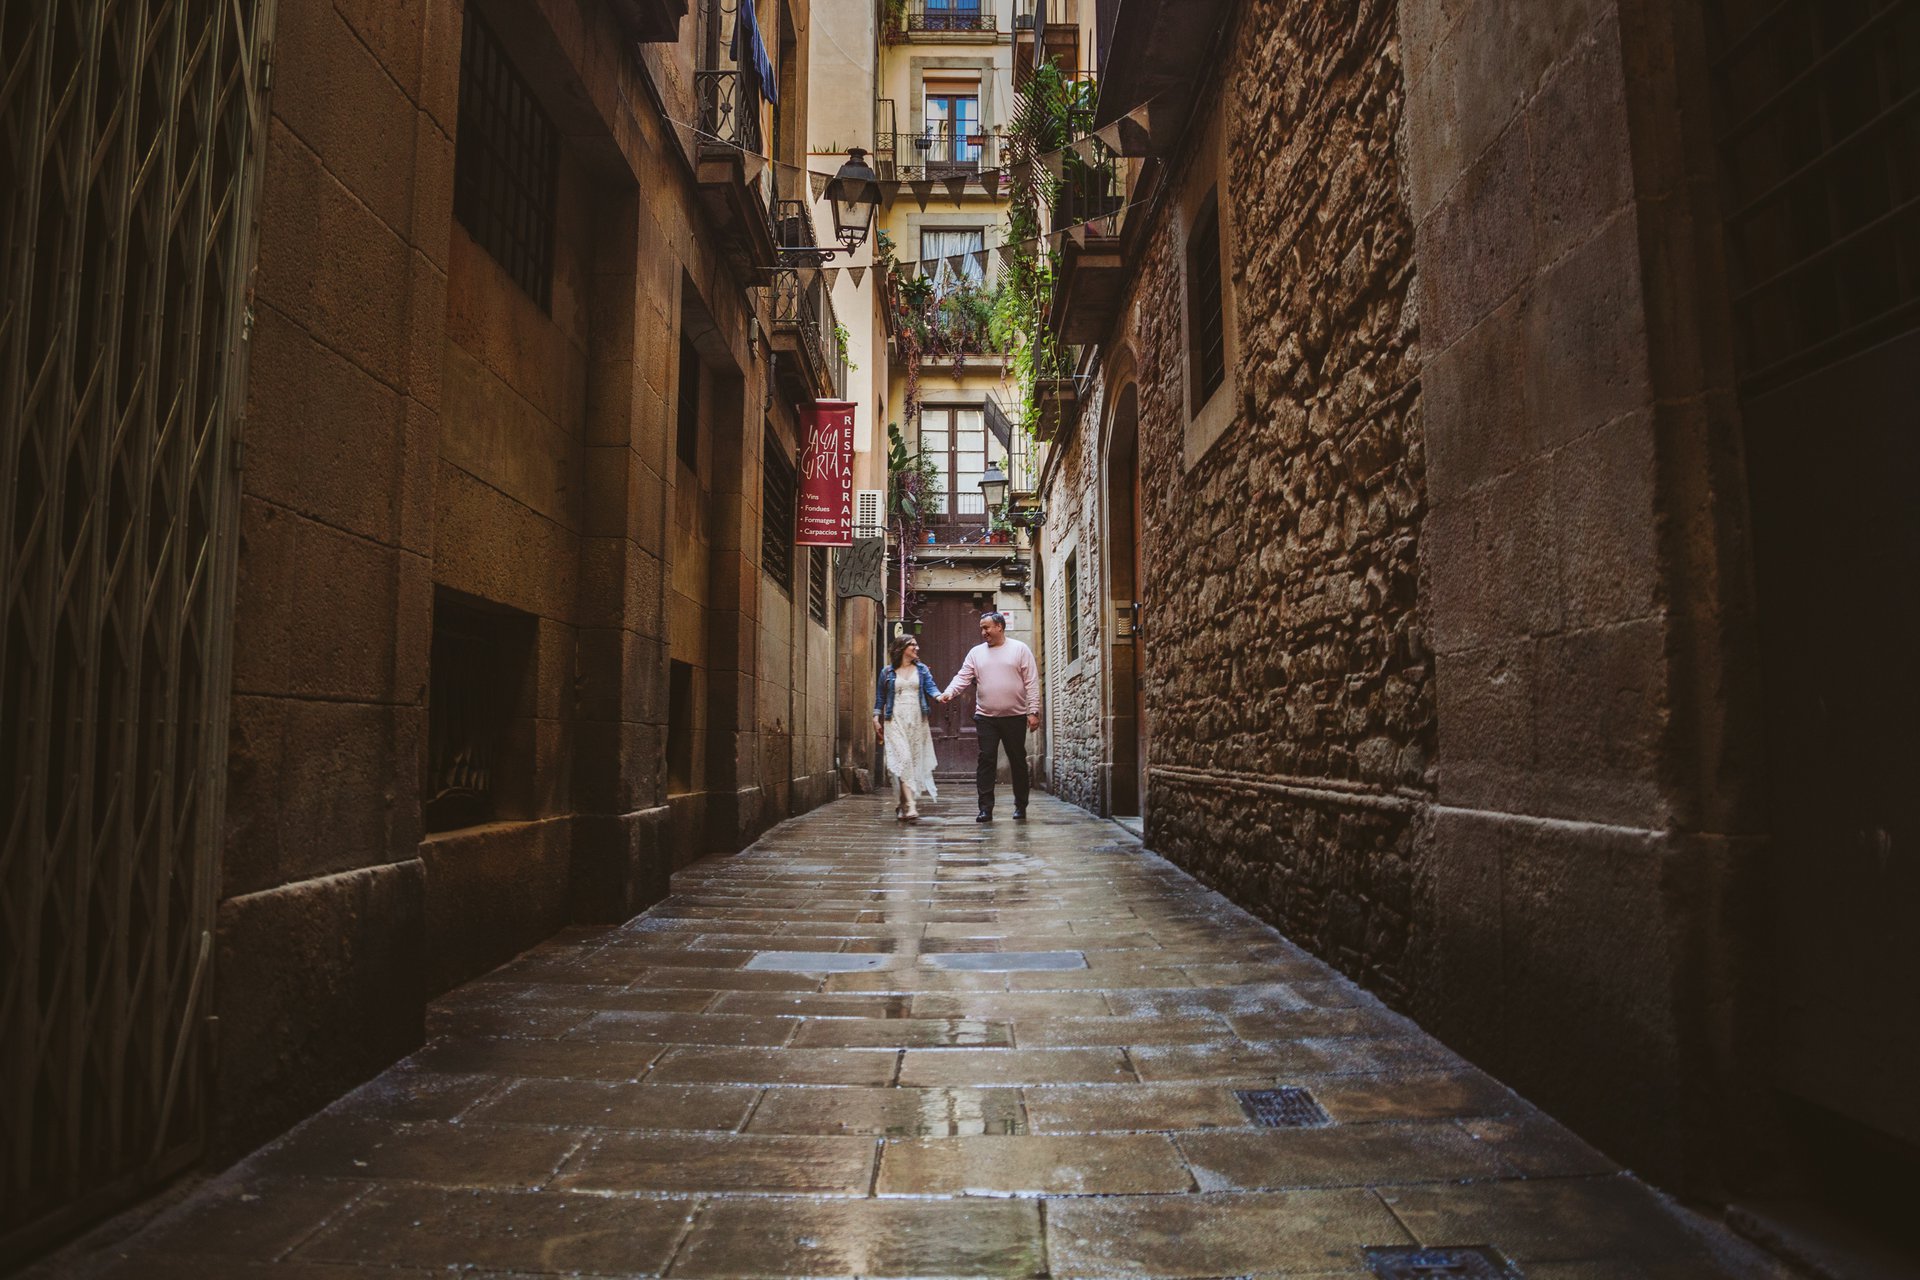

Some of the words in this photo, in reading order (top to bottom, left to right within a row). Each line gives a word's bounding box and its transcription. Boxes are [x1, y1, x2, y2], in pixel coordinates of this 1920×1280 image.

[808, 424, 819, 454] LA
[841, 416, 852, 540] RESTAURANT
[804, 516, 836, 525] Formatges
[804, 528, 838, 536] Carpaccios
